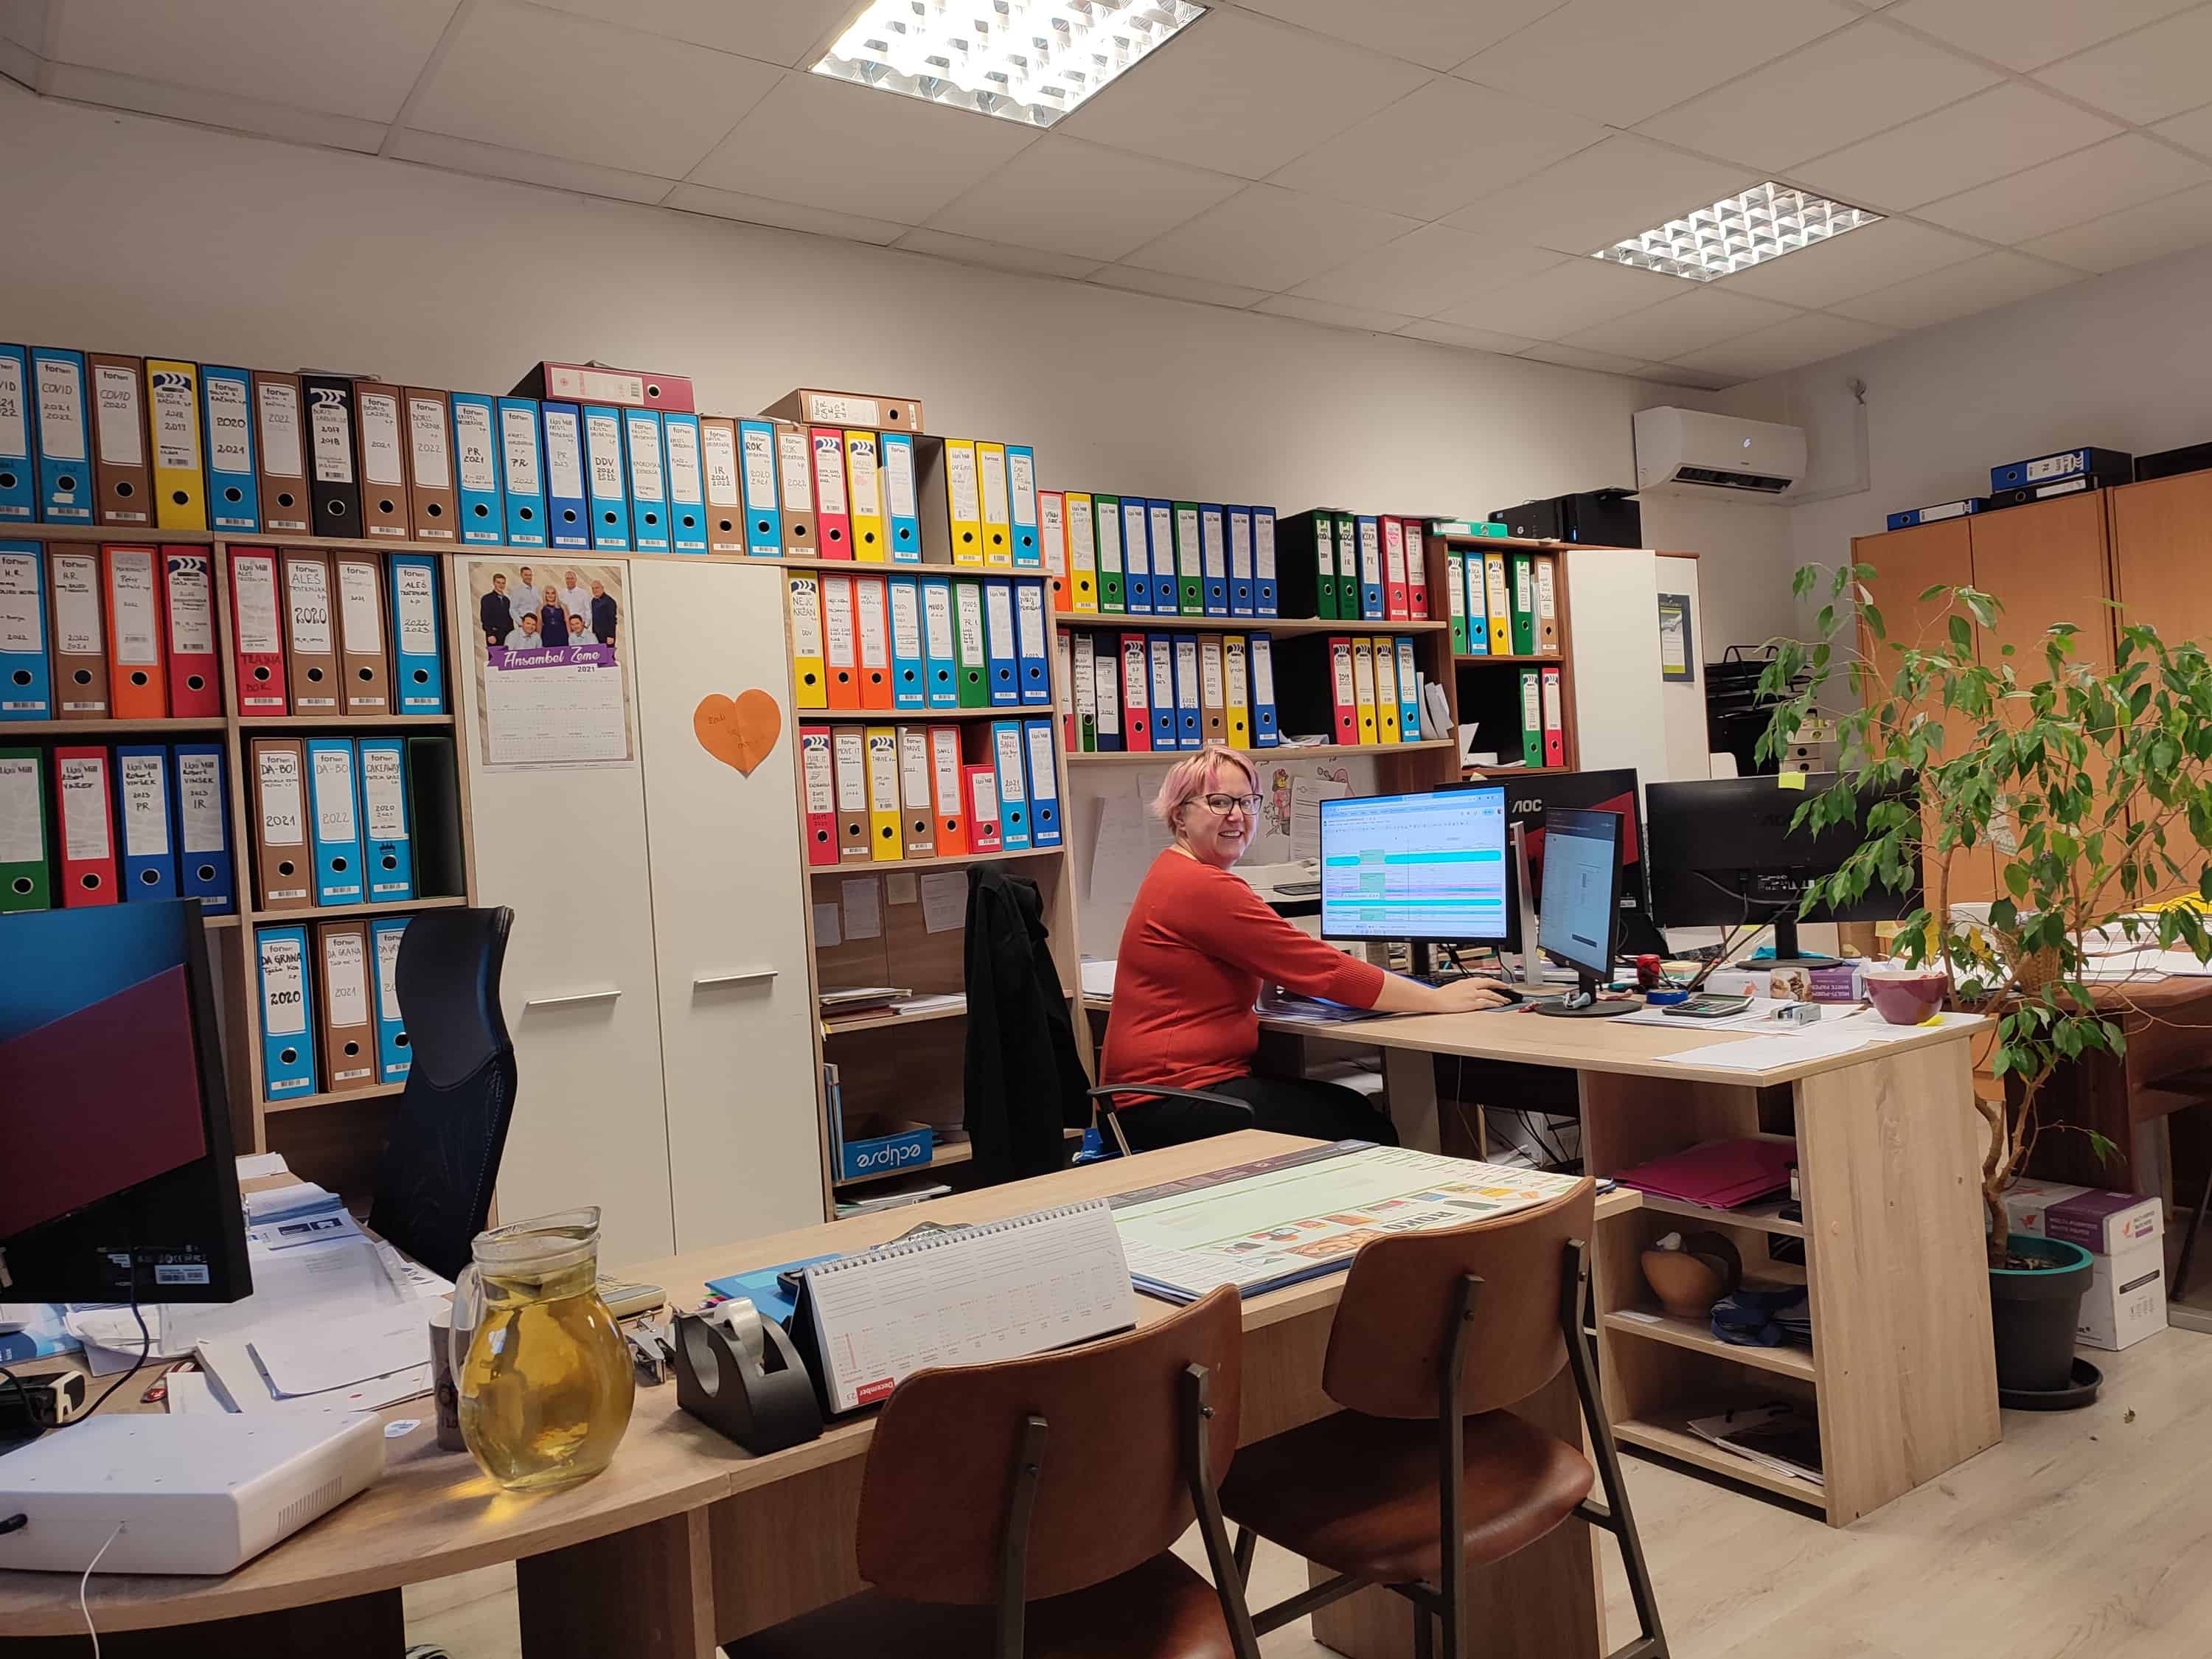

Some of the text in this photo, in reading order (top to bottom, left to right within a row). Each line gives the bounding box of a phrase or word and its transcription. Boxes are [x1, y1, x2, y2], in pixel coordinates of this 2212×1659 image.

[42, 383, 72, 395] COVID
[100, 389, 131, 401] COVID
[217, 417, 246, 428] 2020
[217, 444, 245, 455] 2021
[417, 442, 442, 453] 2022
[467, 447, 481, 456] PR
[746, 442, 762, 451] ROK
[509, 459, 529, 468] PR
[595, 457, 614, 467] DDV
[714, 466, 724, 475] IR
[295, 608, 327, 625] 2020
[504, 650, 564, 667] Ansambel
[136, 801, 151, 812] PR
[194, 799, 207, 809] IR
[1512, 799, 1543, 813] AOC
[266, 815, 296, 827] 2021
[322, 811, 350, 825] 2022
[270, 990, 301, 1006] 2020
[334, 986, 357, 998] 2021
[856, 1144, 921, 1167] eclipse
[859, 1380, 894, 1397] December
